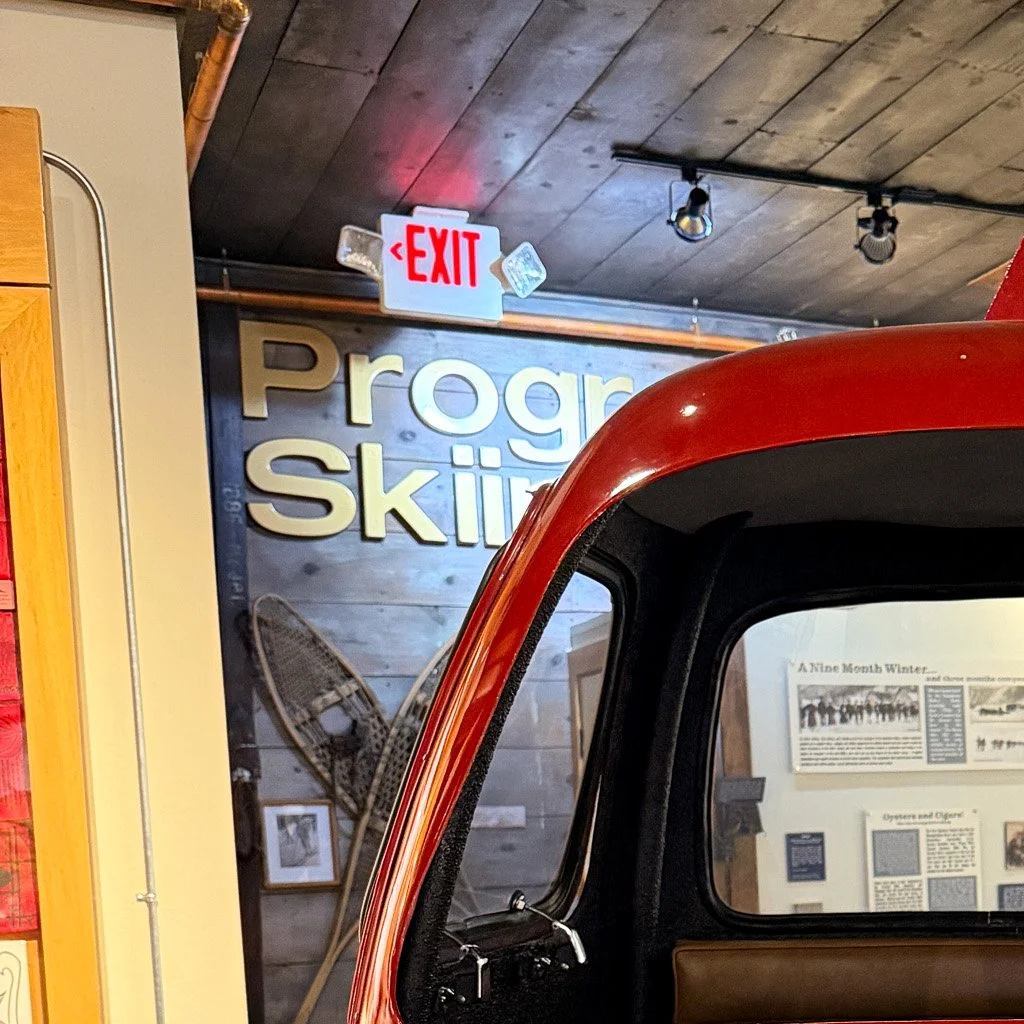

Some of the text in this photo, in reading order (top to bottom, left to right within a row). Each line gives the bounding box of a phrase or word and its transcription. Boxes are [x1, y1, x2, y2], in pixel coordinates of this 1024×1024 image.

[405, 223, 481, 288] EXIT
[798, 662, 808, 673] A
[810, 663, 839, 673] Nine
[841, 663, 883, 673] Month
